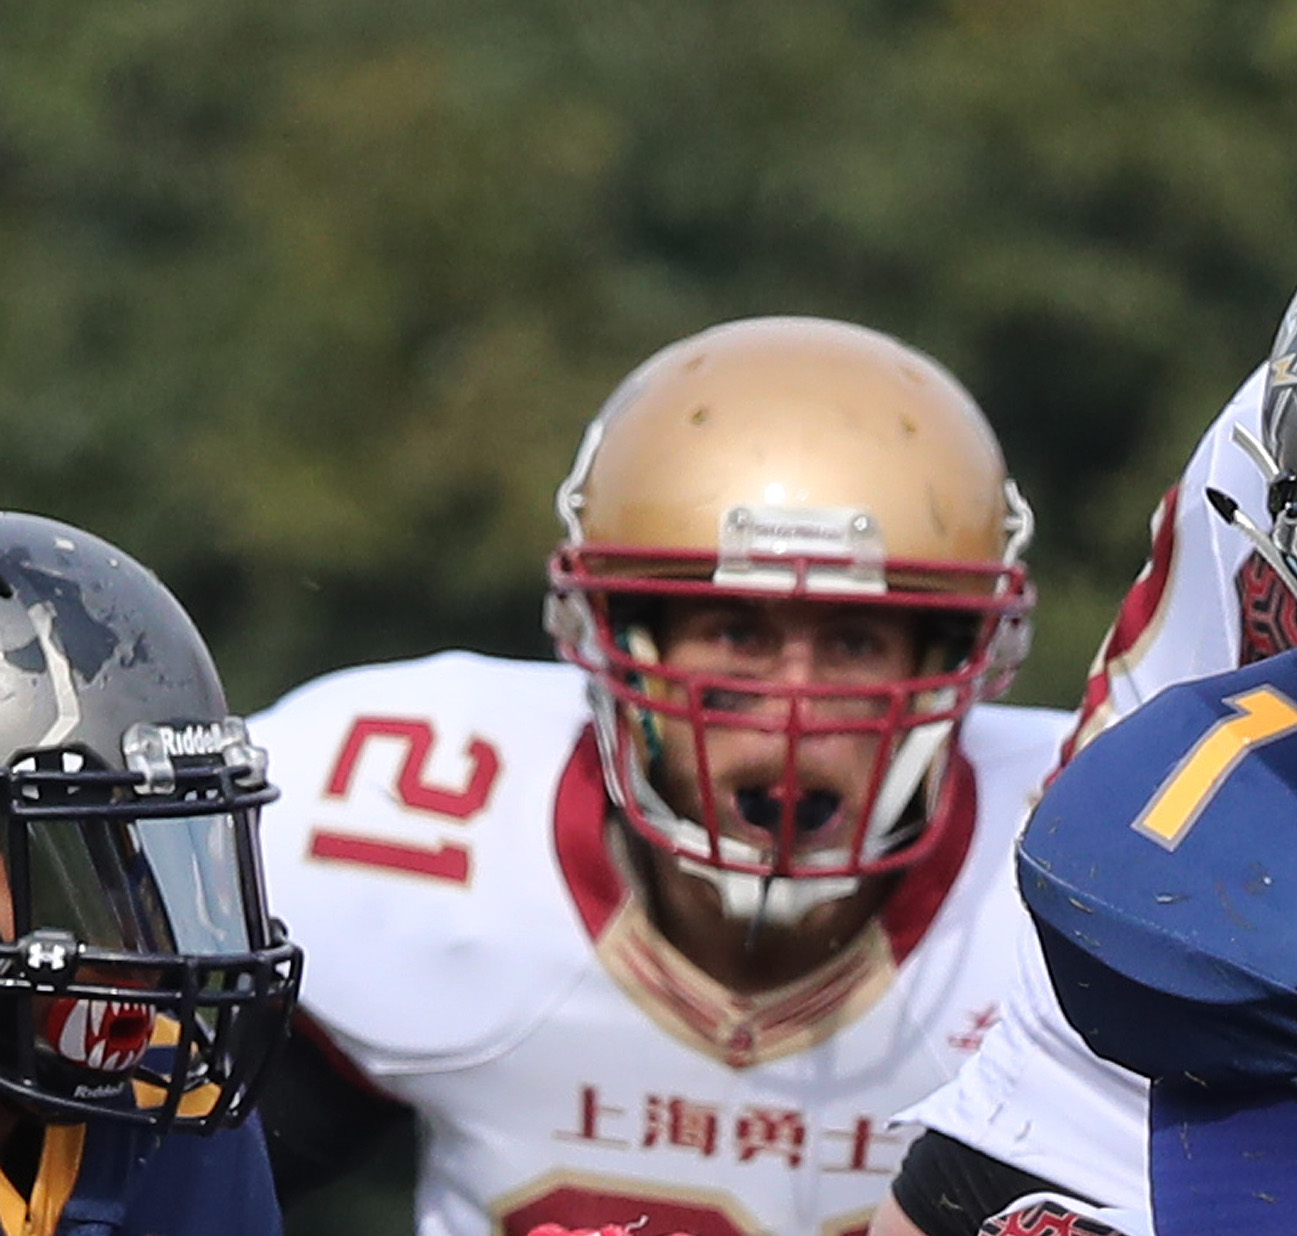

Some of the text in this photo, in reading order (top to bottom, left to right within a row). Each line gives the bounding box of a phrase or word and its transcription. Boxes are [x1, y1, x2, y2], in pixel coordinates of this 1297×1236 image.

[306, 713, 505, 887] 21
[551, 1083, 902, 1174] 上海勇士
